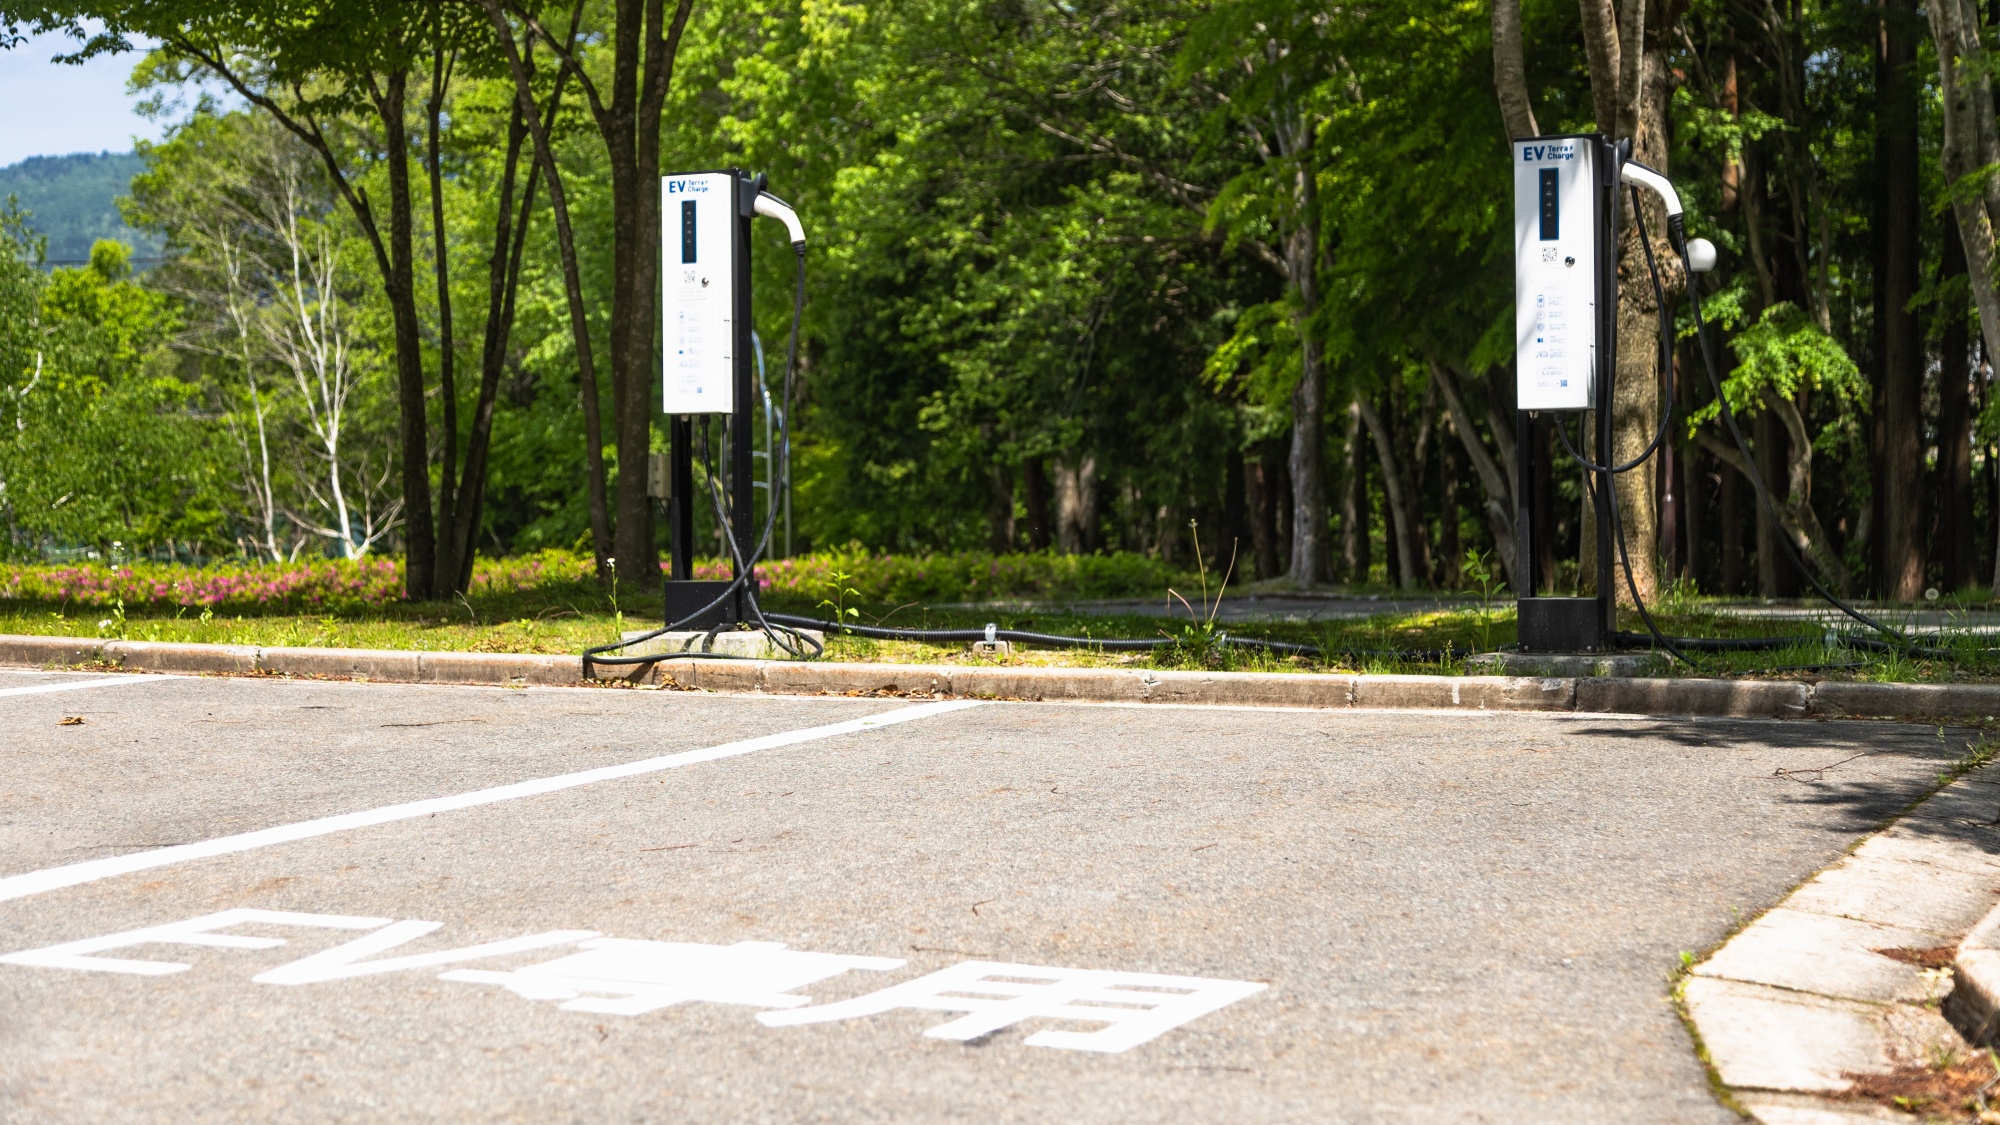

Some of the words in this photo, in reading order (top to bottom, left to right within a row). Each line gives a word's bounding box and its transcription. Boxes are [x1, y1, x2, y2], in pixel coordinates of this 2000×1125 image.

[1523, 146, 1545, 161] EV
[1548, 152, 1574, 160] Charge
[669, 180, 686, 193] EV
